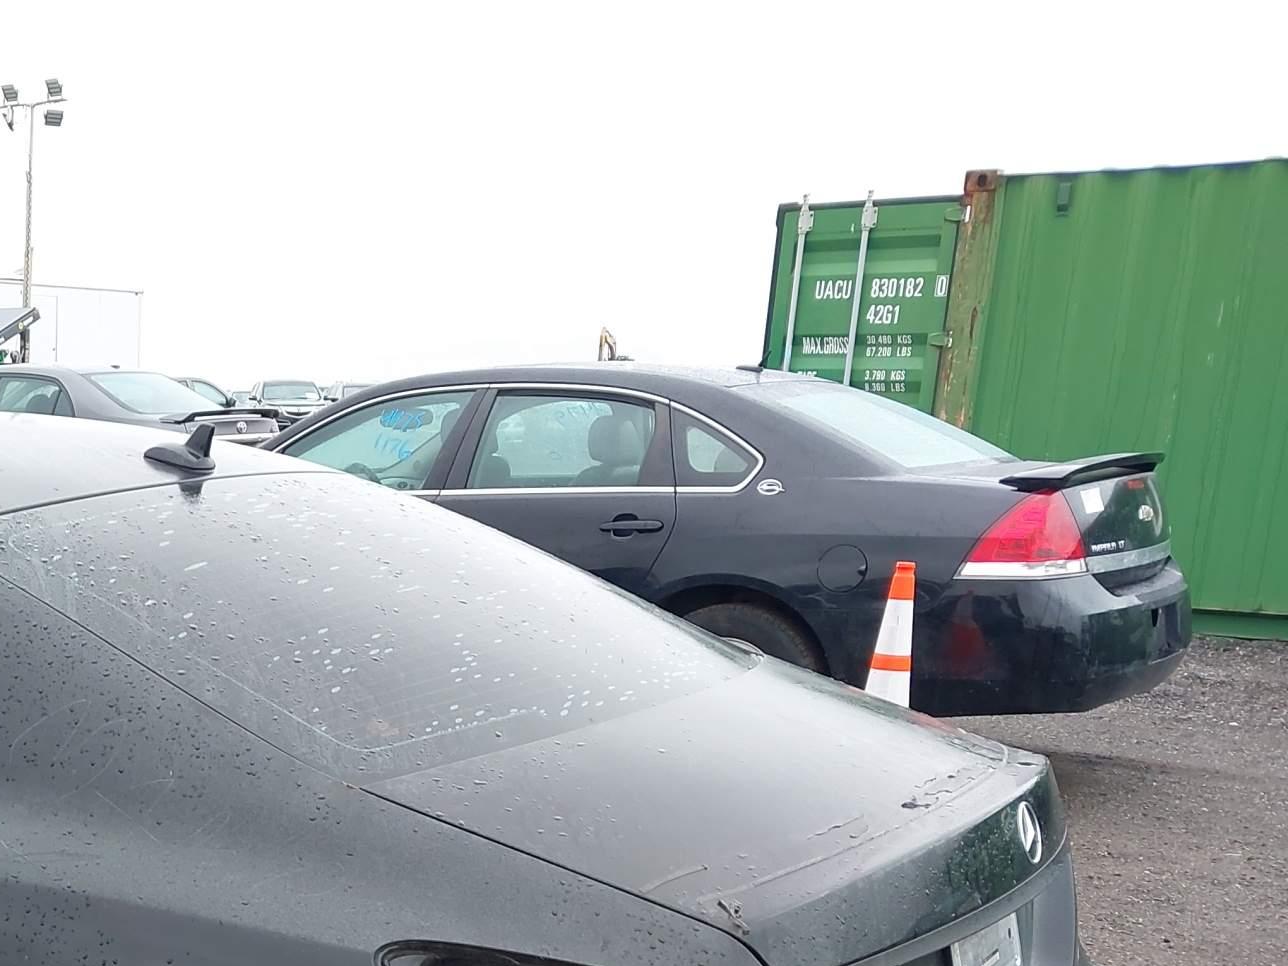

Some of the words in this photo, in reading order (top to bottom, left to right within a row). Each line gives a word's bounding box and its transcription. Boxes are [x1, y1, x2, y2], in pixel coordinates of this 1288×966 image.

[815, 279, 853, 300] UACU
[870, 277, 924, 298] 830182
[866, 304, 900, 324] 42G1
[897, 334, 912, 344] KGS
[896, 346, 912, 357] LBS
[890, 370, 906, 381] KGS
[890, 382, 906, 392] LBS
